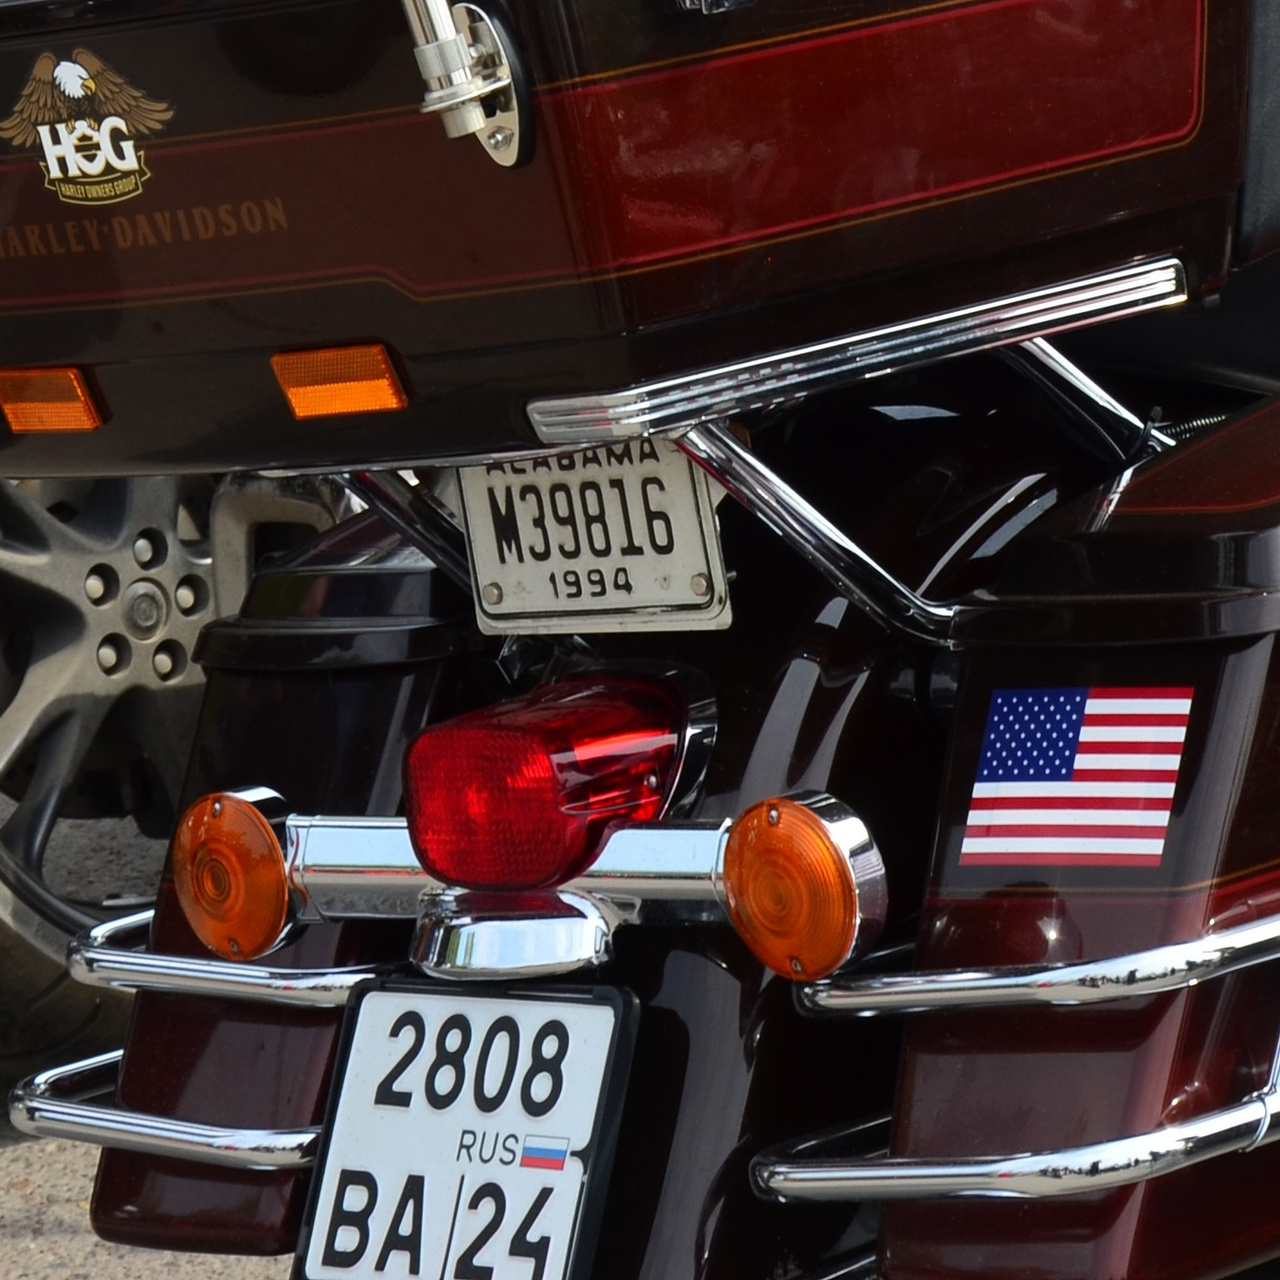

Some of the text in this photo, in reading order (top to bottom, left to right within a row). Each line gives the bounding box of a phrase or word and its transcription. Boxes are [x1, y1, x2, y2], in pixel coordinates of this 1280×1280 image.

[37, 116, 139, 179] HOG
[60, 175, 137, 198] HARLEY OWNERS GROUP
[487, 476, 675, 565] M39816
[549, 567, 633, 600] 1994
[374, 1010, 570, 1118] 2808
[456, 1129, 519, 1166] RUS
[454, 1182, 554, 1280] 24
